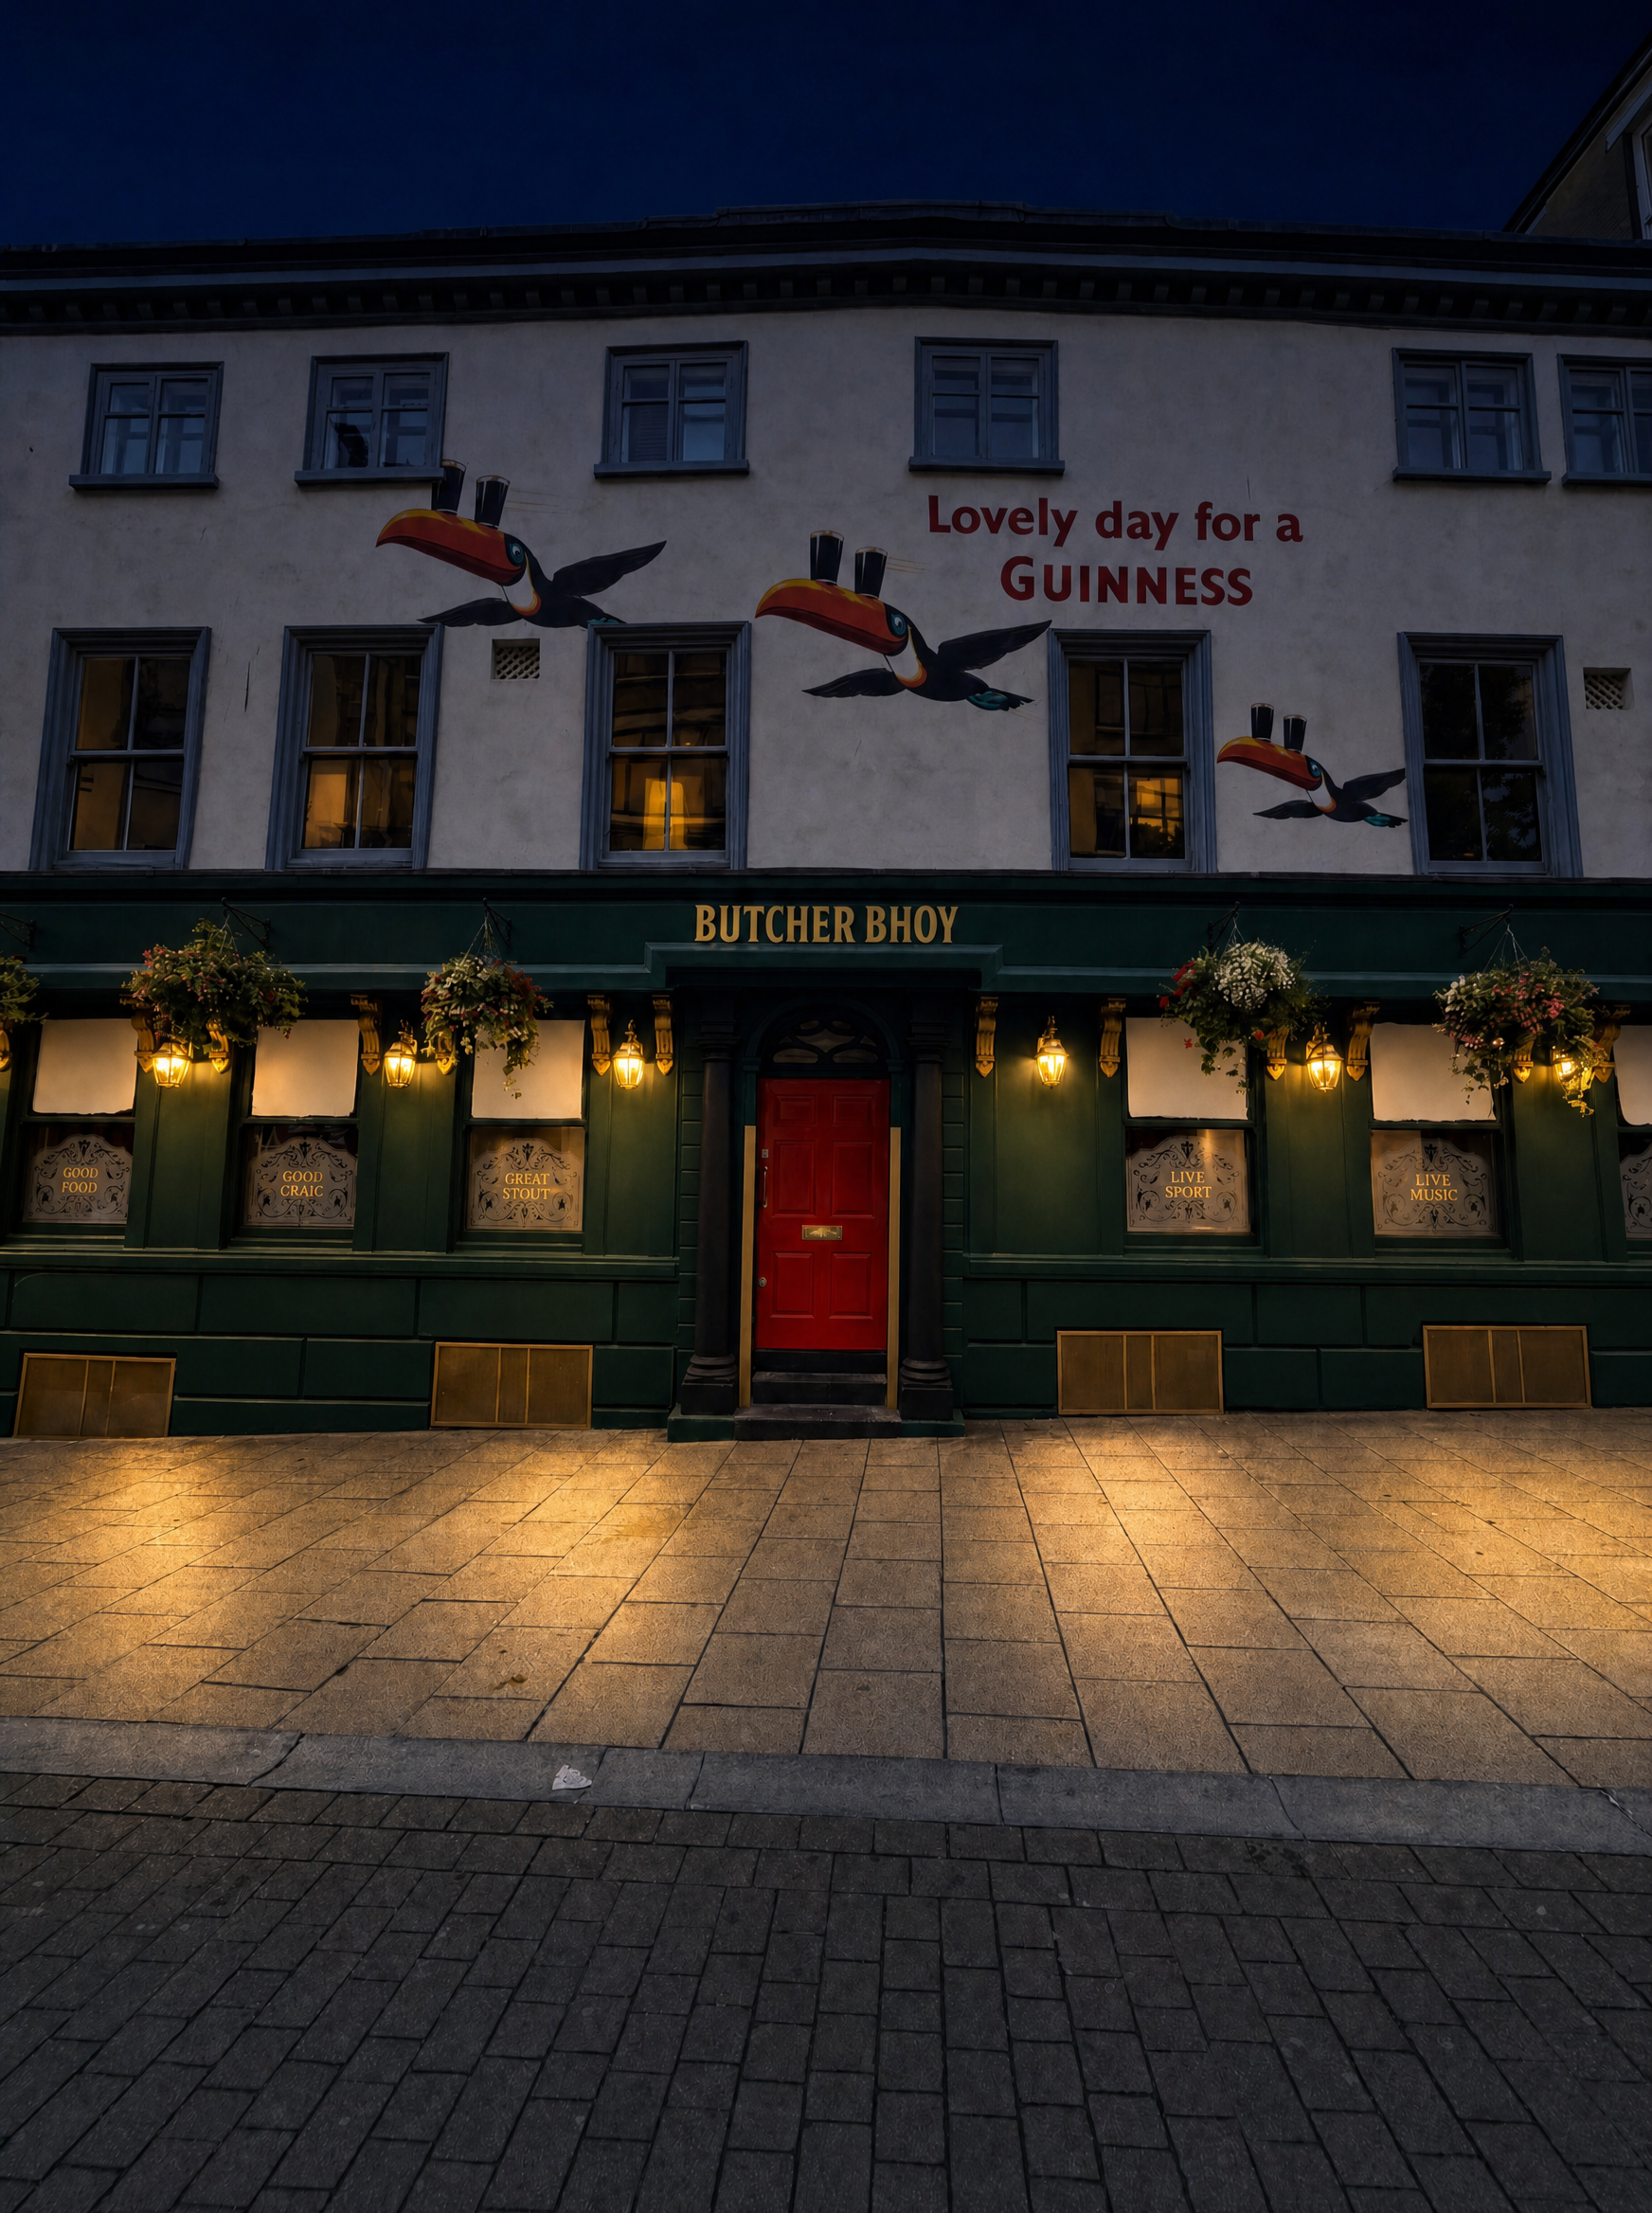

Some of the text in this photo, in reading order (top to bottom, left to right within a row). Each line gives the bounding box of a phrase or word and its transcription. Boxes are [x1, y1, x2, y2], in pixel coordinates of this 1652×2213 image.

[927, 495, 1303, 551] Lovely day for a
[1000, 555, 1253, 606] GUINNESS
[694, 904, 959, 944] BUTCHER BHOY
[63, 1166, 99, 1179] GOOD
[282, 1170, 323, 1183] GOOD
[505, 1172, 549, 1185] GREAT
[1170, 1171, 1205, 1184] LIVE
[1415, 1174, 1451, 1186] LIVE
[62, 1181, 98, 1194] FOOD
[279, 1184, 324, 1197] CRAIC
[502, 1187, 550, 1200] STOUT
[1164, 1185, 1212, 1199] SPORT
[1410, 1187, 1458, 1202] MUSIC
